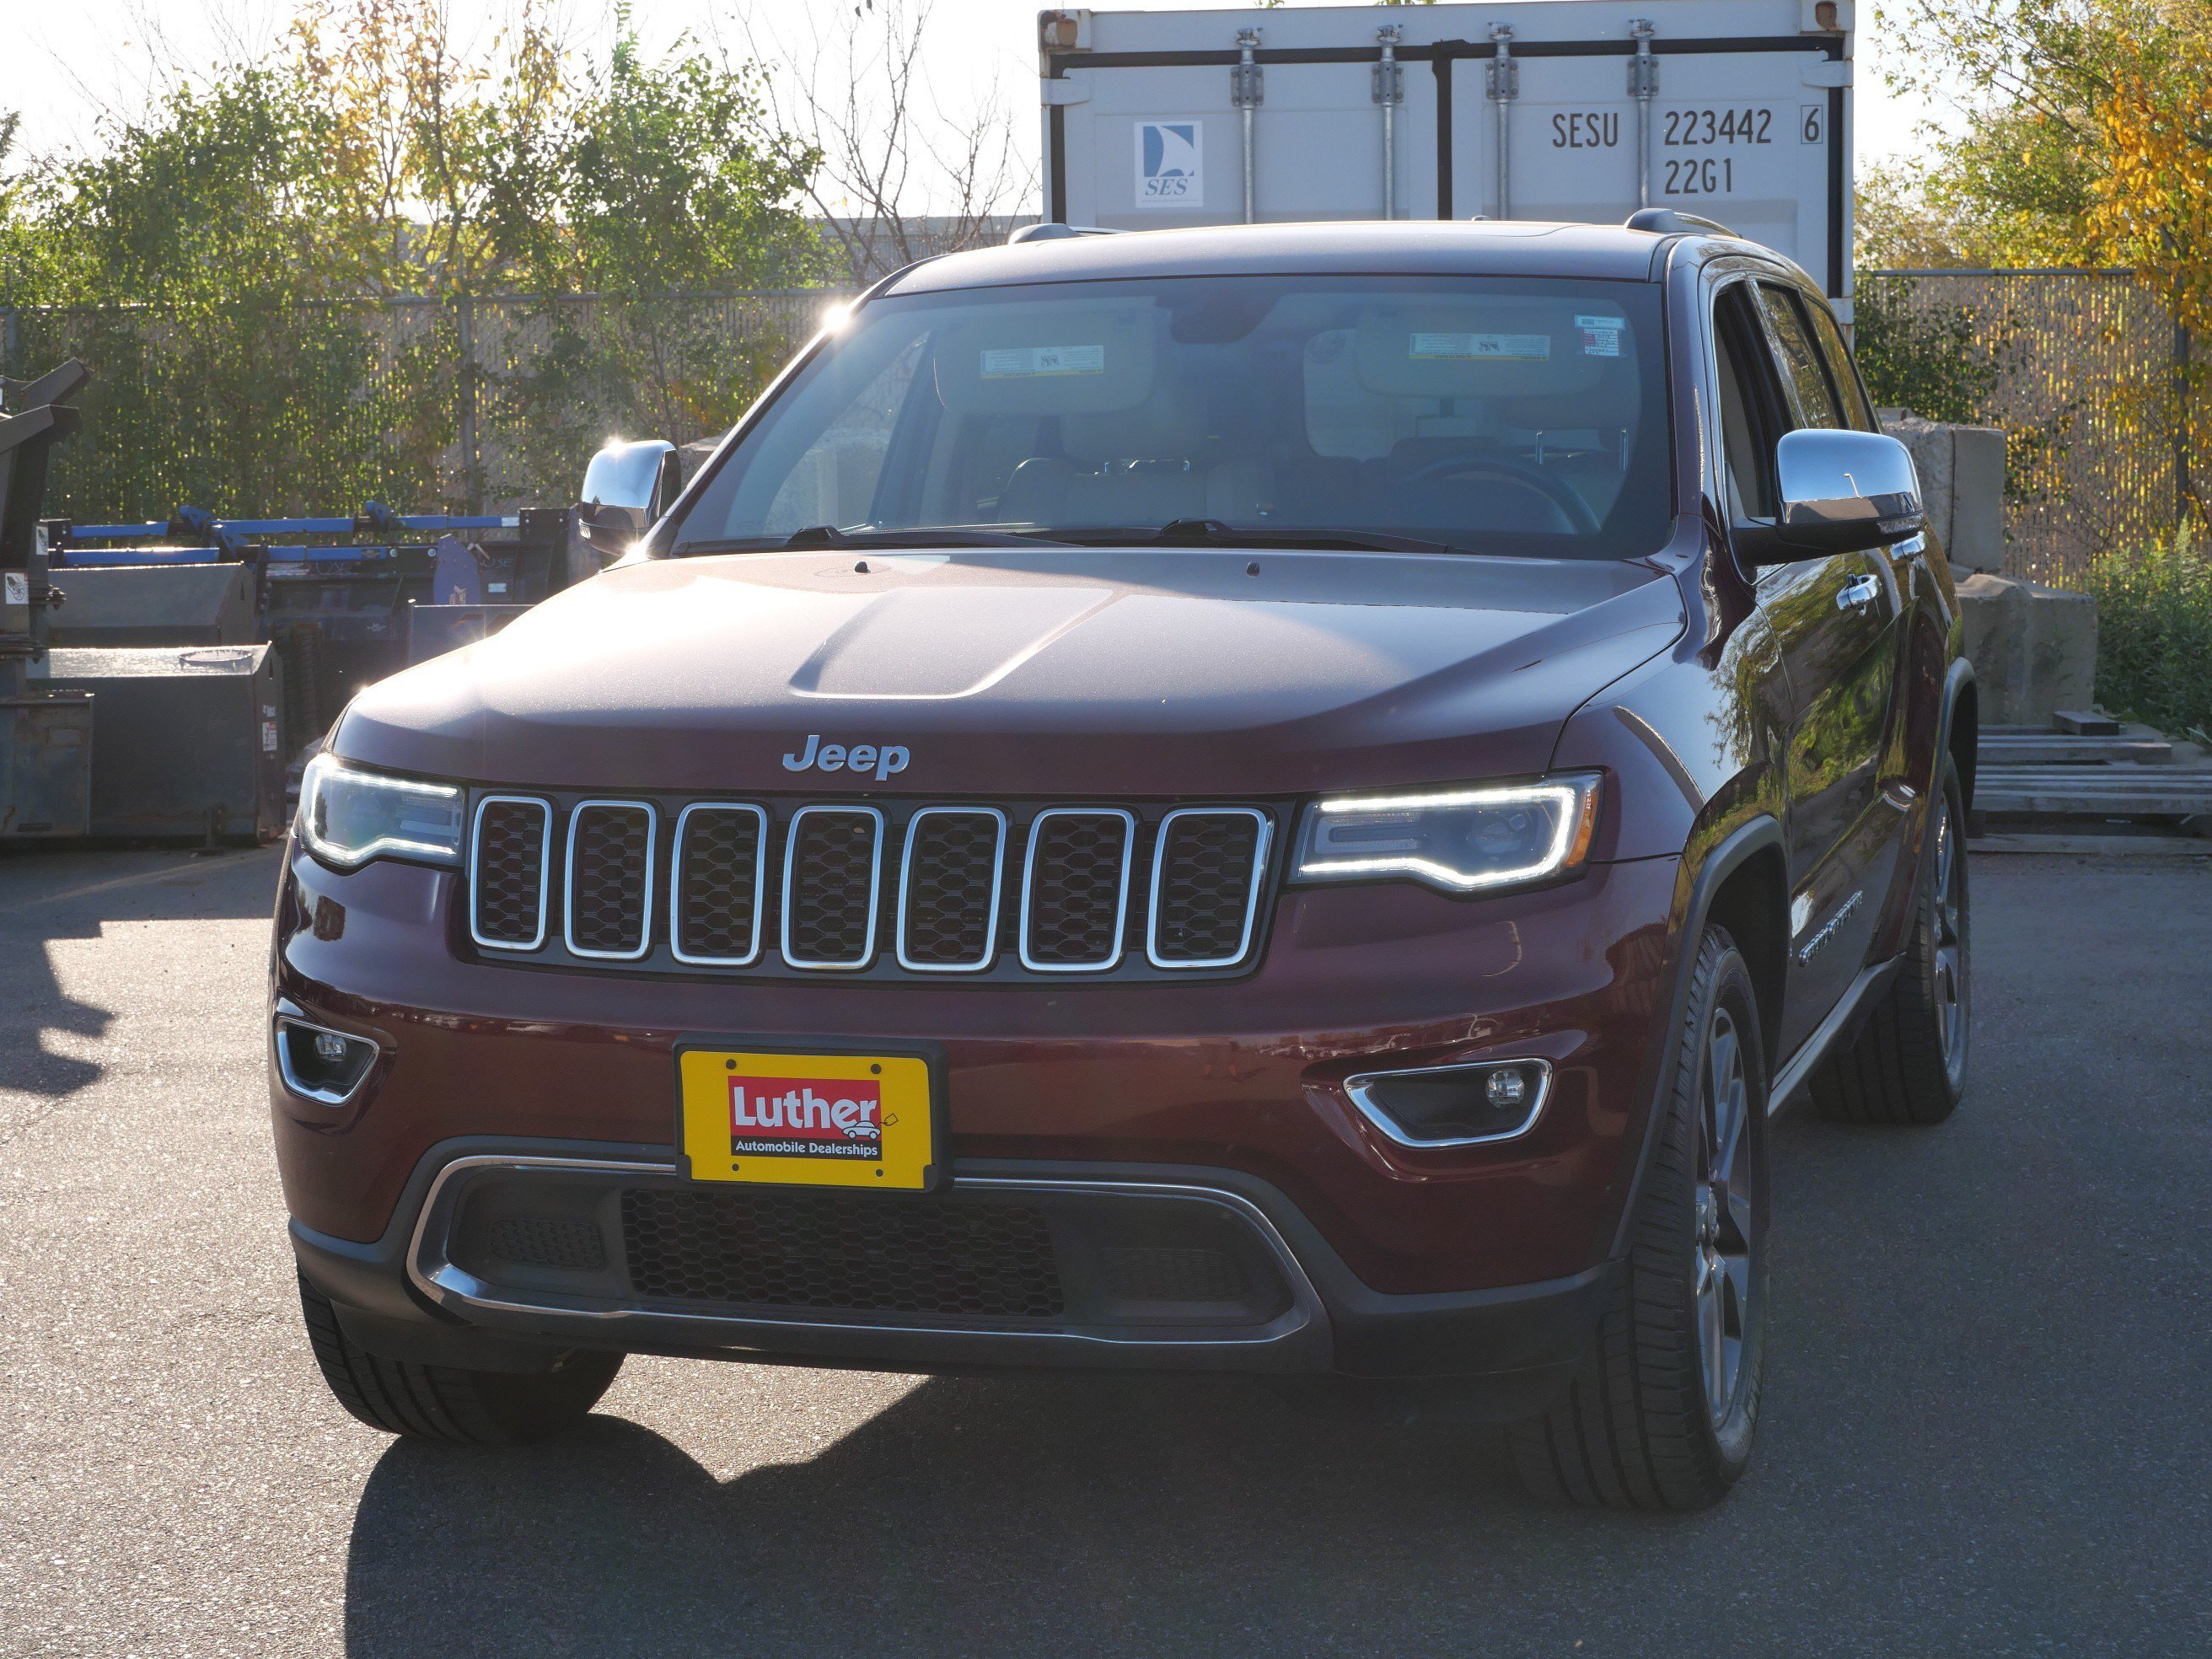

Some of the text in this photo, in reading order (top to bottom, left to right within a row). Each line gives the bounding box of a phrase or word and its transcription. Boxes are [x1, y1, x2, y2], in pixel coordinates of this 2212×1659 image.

[1552, 107, 1820, 148] SESU 223442 6
[1145, 178, 1189, 196] SES
[1664, 158, 1732, 194] 22G1
[782, 734, 910, 781] Jeep
[733, 1086, 877, 1129] Luther
[735, 1140, 878, 1157] Automobile Dealerships
